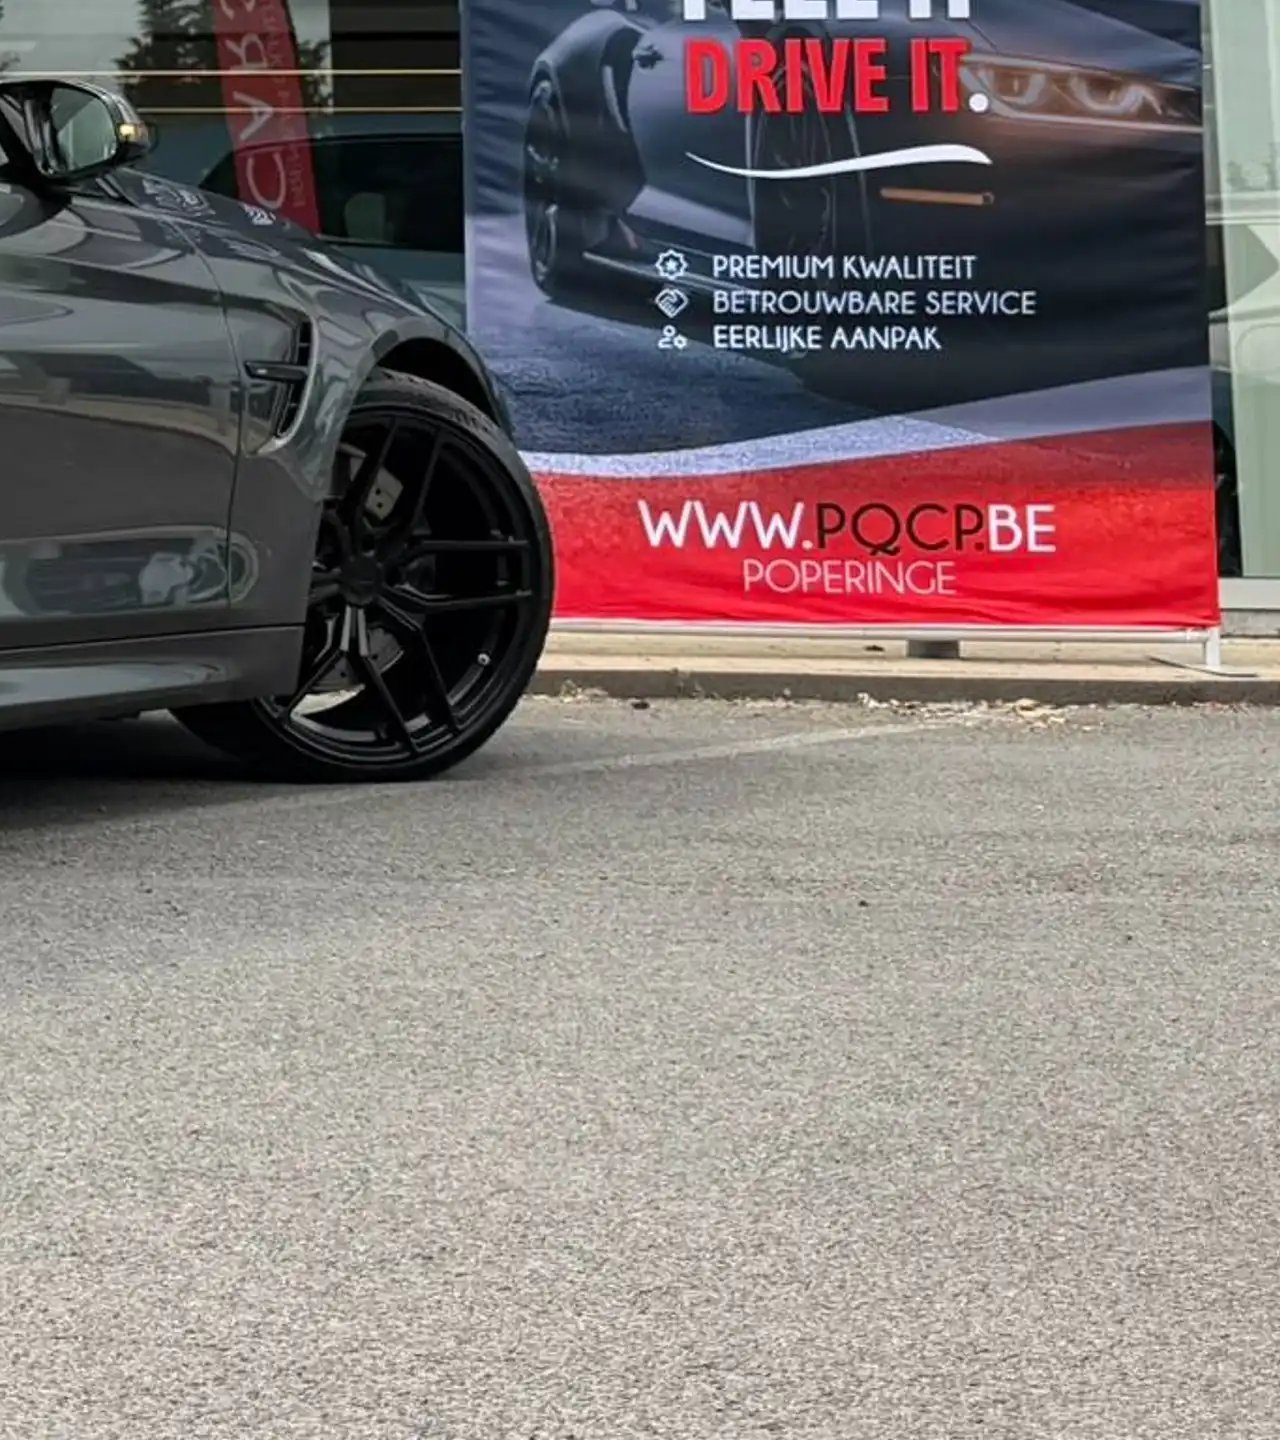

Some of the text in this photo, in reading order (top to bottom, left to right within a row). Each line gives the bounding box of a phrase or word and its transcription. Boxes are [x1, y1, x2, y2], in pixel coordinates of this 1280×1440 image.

[685, 38, 990, 114] DRIVE IT.
[712, 254, 976, 280] PREMIUM KWALITEIT
[713, 289, 1036, 316] BETROUWBARE SERVICE
[713, 324, 942, 352] EERLIJKE AANPAK
[638, 500, 1057, 556] WWW.PQCP.BE
[743, 559, 956, 595] POPERINGE
